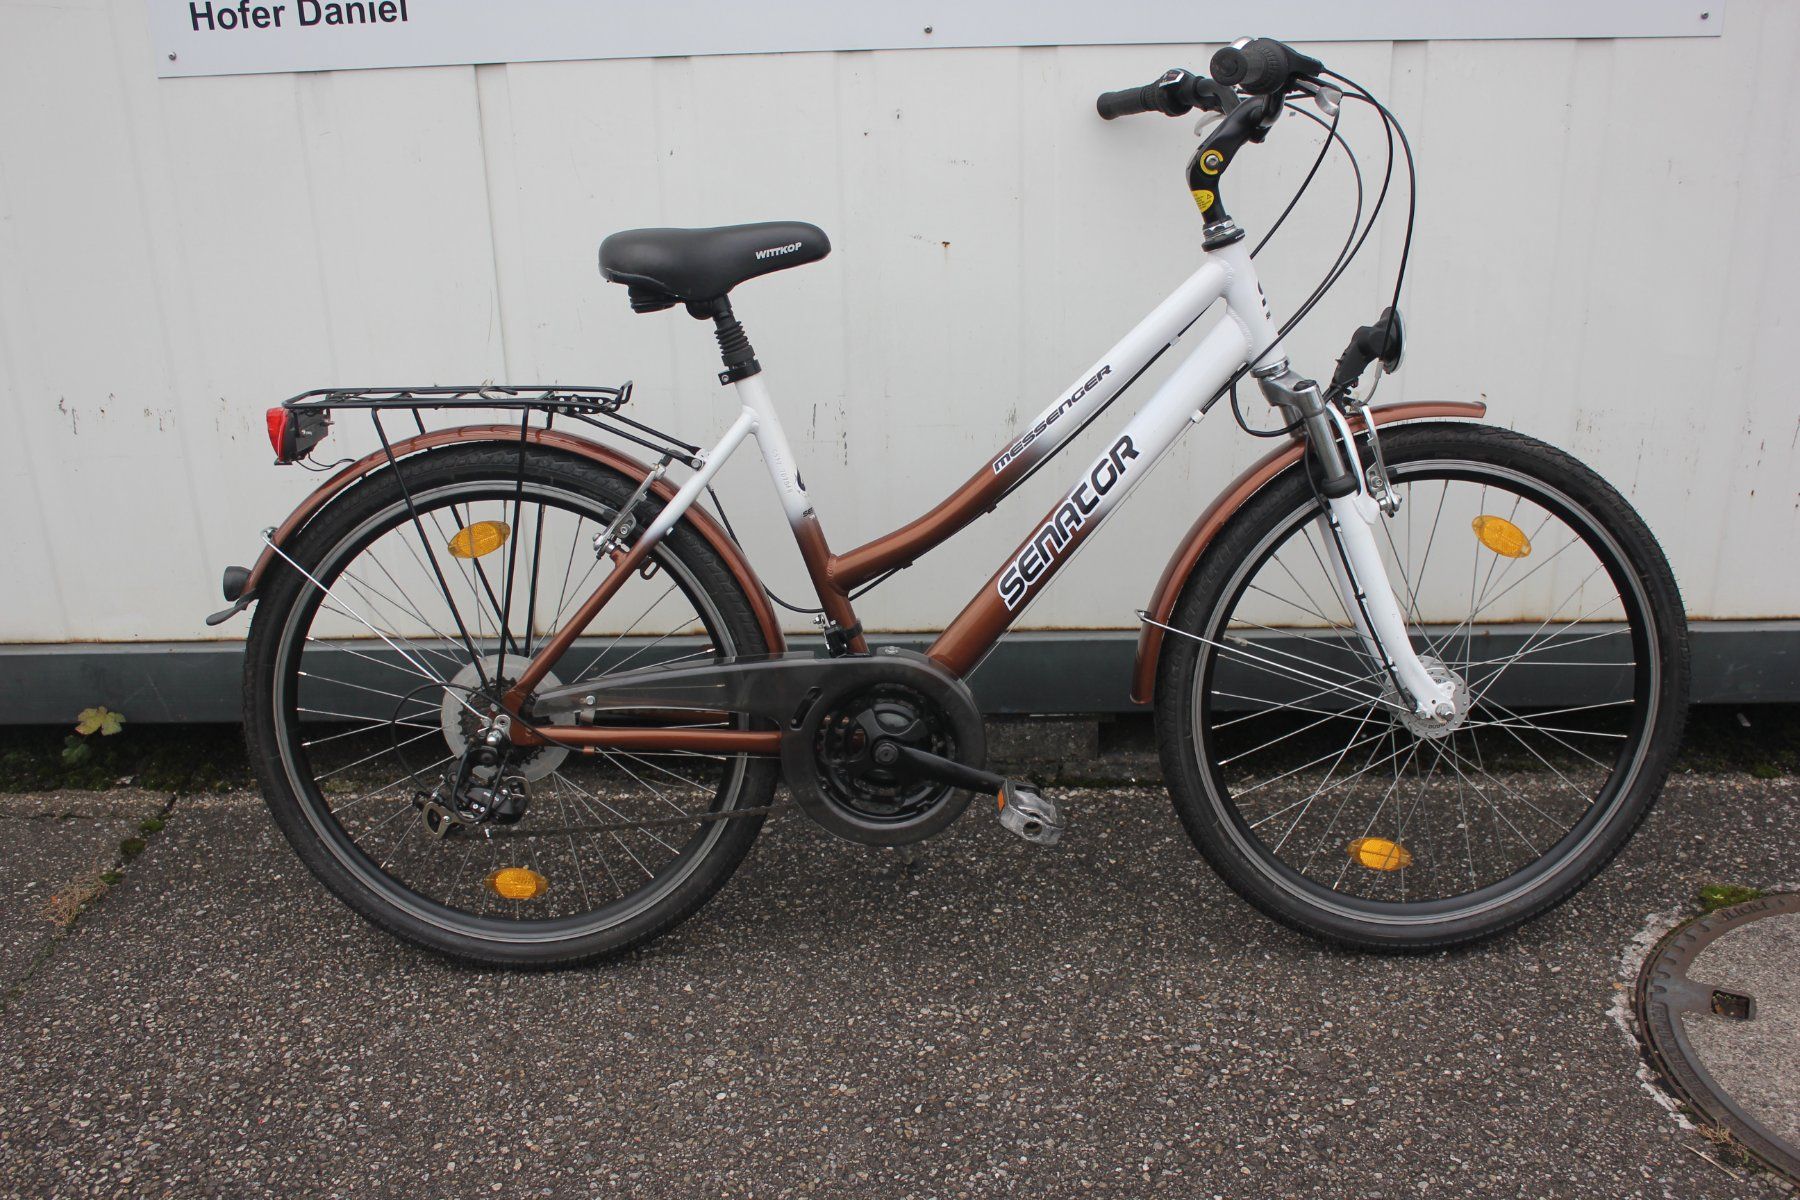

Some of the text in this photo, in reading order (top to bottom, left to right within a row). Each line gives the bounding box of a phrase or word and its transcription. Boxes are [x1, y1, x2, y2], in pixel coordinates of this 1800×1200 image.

[189, 0, 409, 31] Hofer Daniel
[755, 241, 803, 260] WITTKOP
[998, 433, 1141, 610] SENATOR
